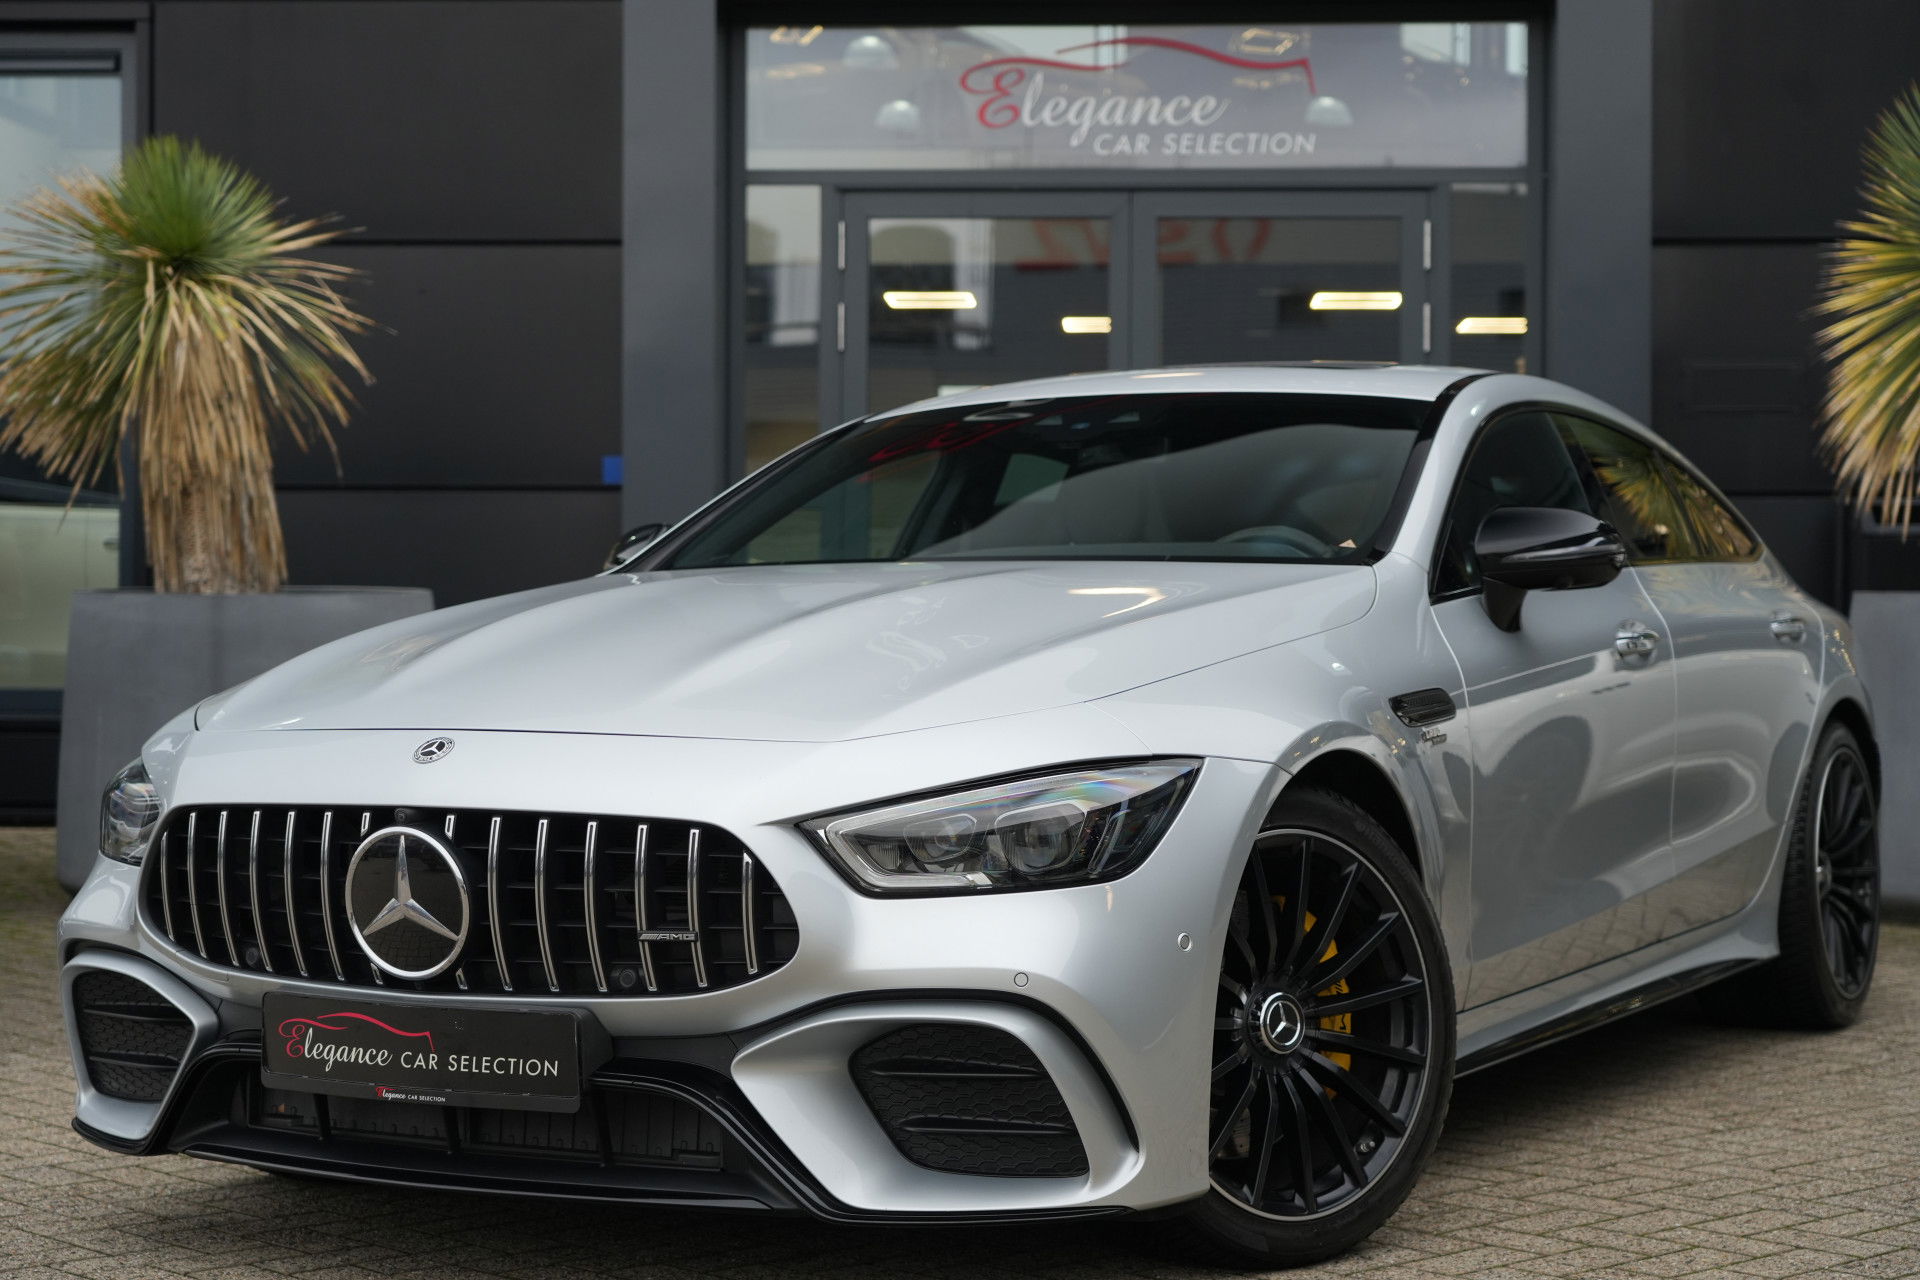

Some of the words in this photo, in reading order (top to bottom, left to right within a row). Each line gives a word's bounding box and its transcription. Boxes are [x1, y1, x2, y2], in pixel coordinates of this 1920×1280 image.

[960, 57, 1231, 147] Elegance
[1093, 133, 1150, 155] CAR
[1162, 132, 1316, 154] SELECTION
[279, 1018, 393, 1072] Elegance
[401, 1051, 438, 1070] CAR
[448, 1054, 558, 1077] SELECTION
